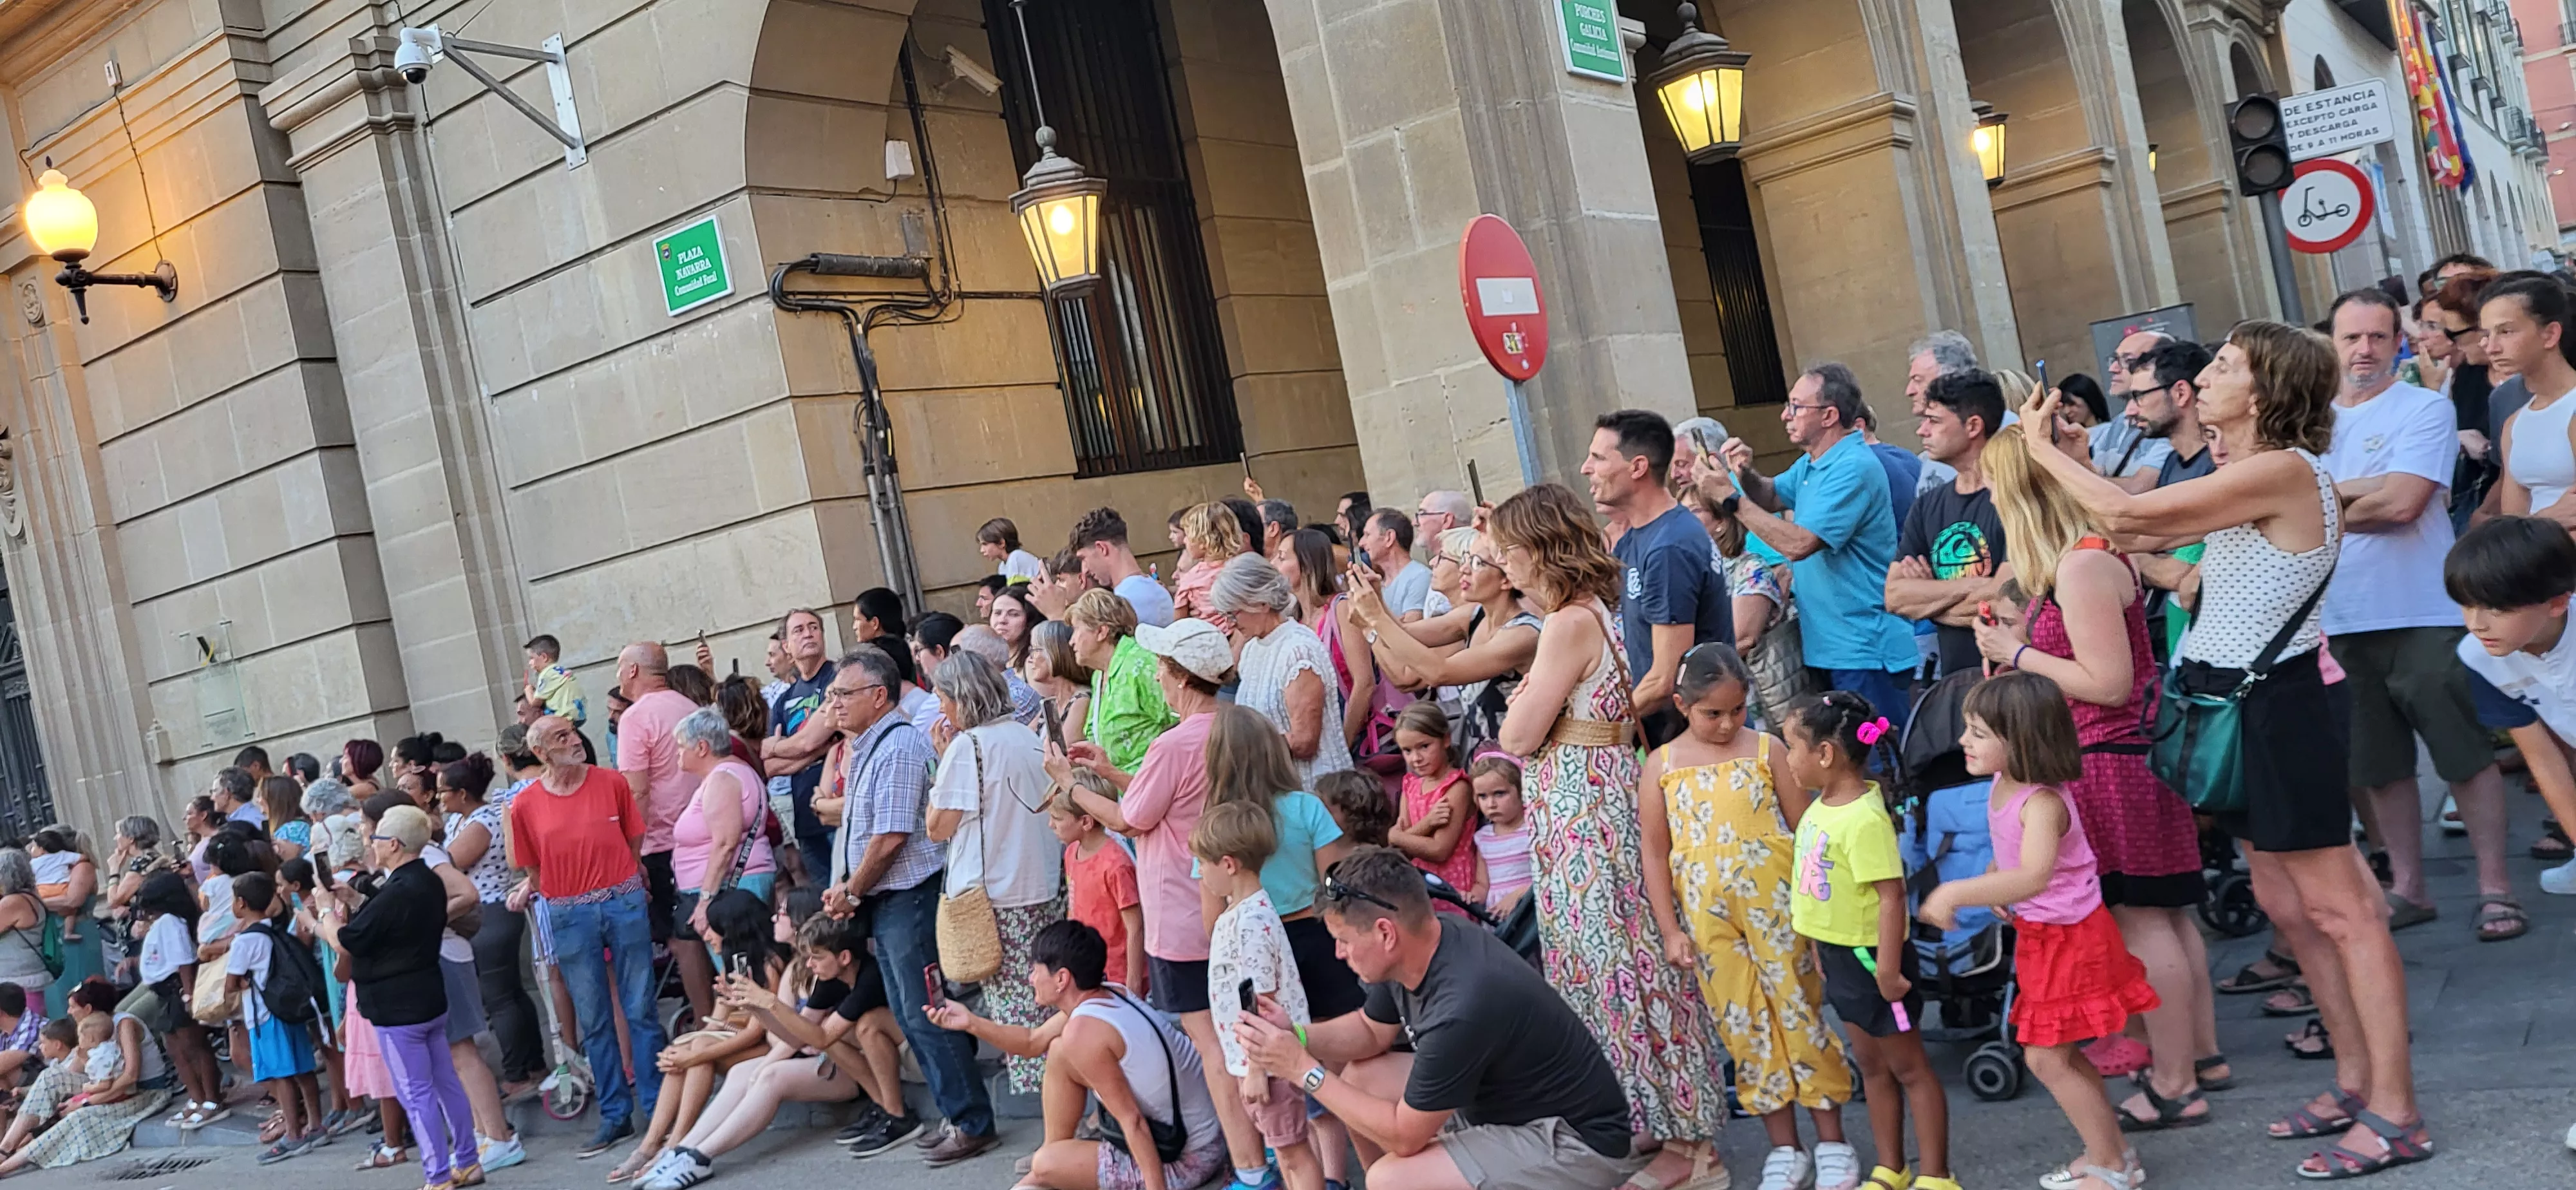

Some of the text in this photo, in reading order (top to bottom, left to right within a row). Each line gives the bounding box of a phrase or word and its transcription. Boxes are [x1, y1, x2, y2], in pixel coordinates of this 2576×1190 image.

[2284, 89, 2376, 117] DE ESTANCIA
[2286, 102, 2378, 129] EXCEPTO CARGA
[2289, 144, 2304, 153] DE
[2328, 137, 2337, 145] 11
[2340, 126, 2379, 142] HORAS
[2298, 118, 2358, 138] DESCARGA
[677, 245, 704, 265] PLAZA
[675, 258, 712, 281] NAVARRA
